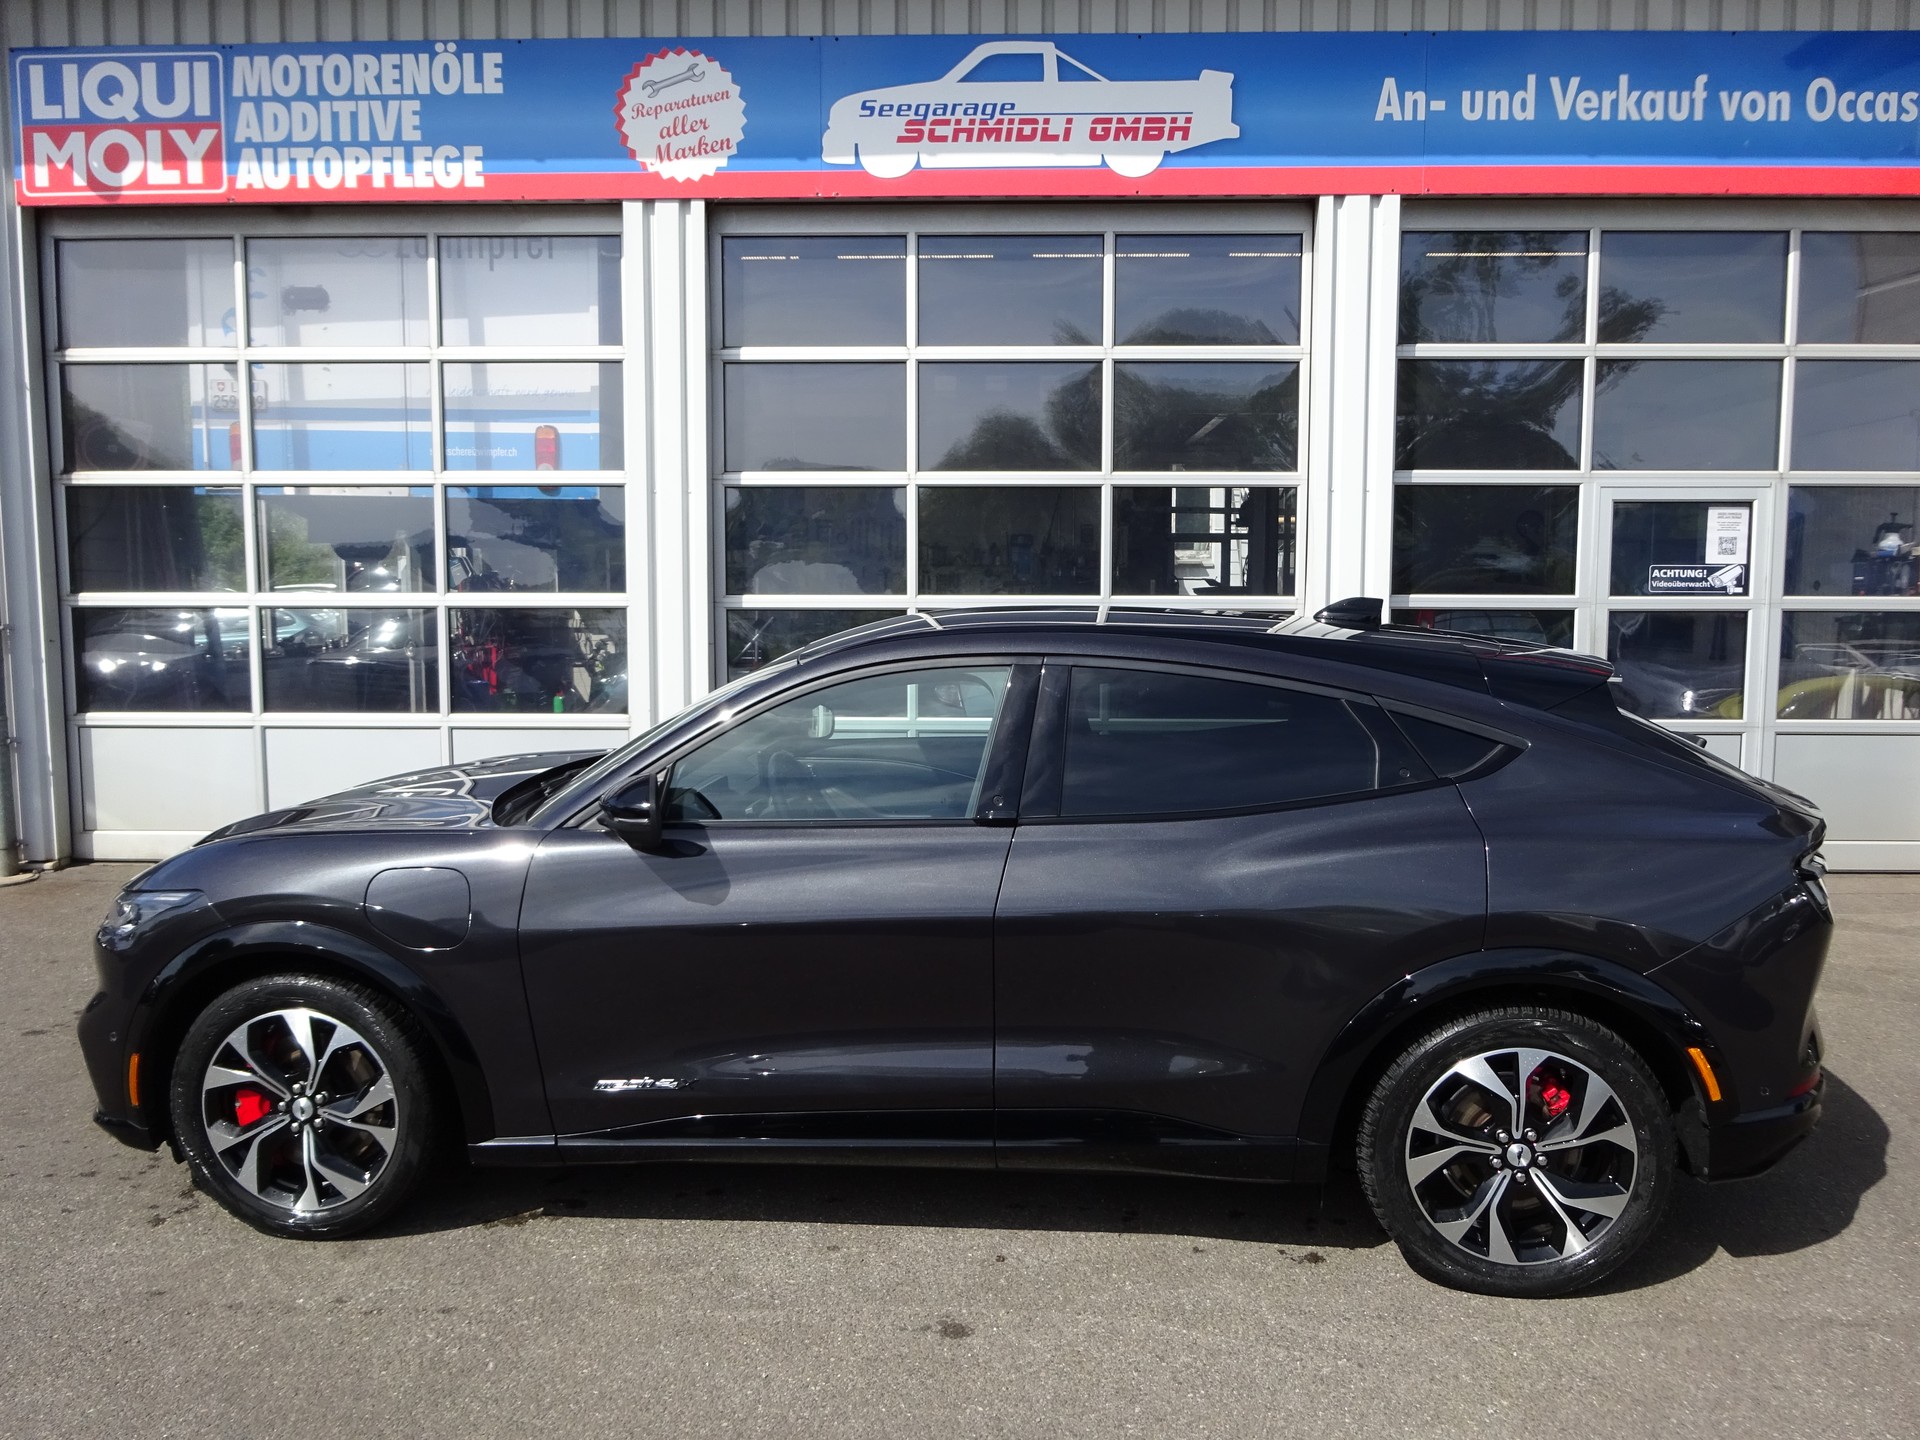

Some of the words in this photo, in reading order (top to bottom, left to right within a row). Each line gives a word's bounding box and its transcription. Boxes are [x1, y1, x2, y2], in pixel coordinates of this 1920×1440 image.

[232, 42, 504, 97] MOTORENÖLE
[29, 61, 212, 122] LIQUI
[631, 90, 732, 119] Reparaturen
[1374, 77, 1446, 121] An-
[1461, 74, 1536, 121] und
[1549, 74, 1709, 121] Verkauf
[1719, 90, 1791, 122] von
[1806, 77, 1919, 122] Occas
[234, 100, 422, 143] ADDITIVE
[859, 100, 1016, 121] Seegarage
[659, 114, 710, 139] aller
[896, 117, 1075, 143] SCHMIDLI
[1088, 116, 1194, 142] GMBH
[33, 128, 219, 187] MOLY
[650, 135, 733, 166] Marken
[235, 145, 485, 189] AUTOPFLEGE
[1652, 569, 1708, 578] ACHTUNG!
[1652, 580, 1711, 588] Videoüberwacht
